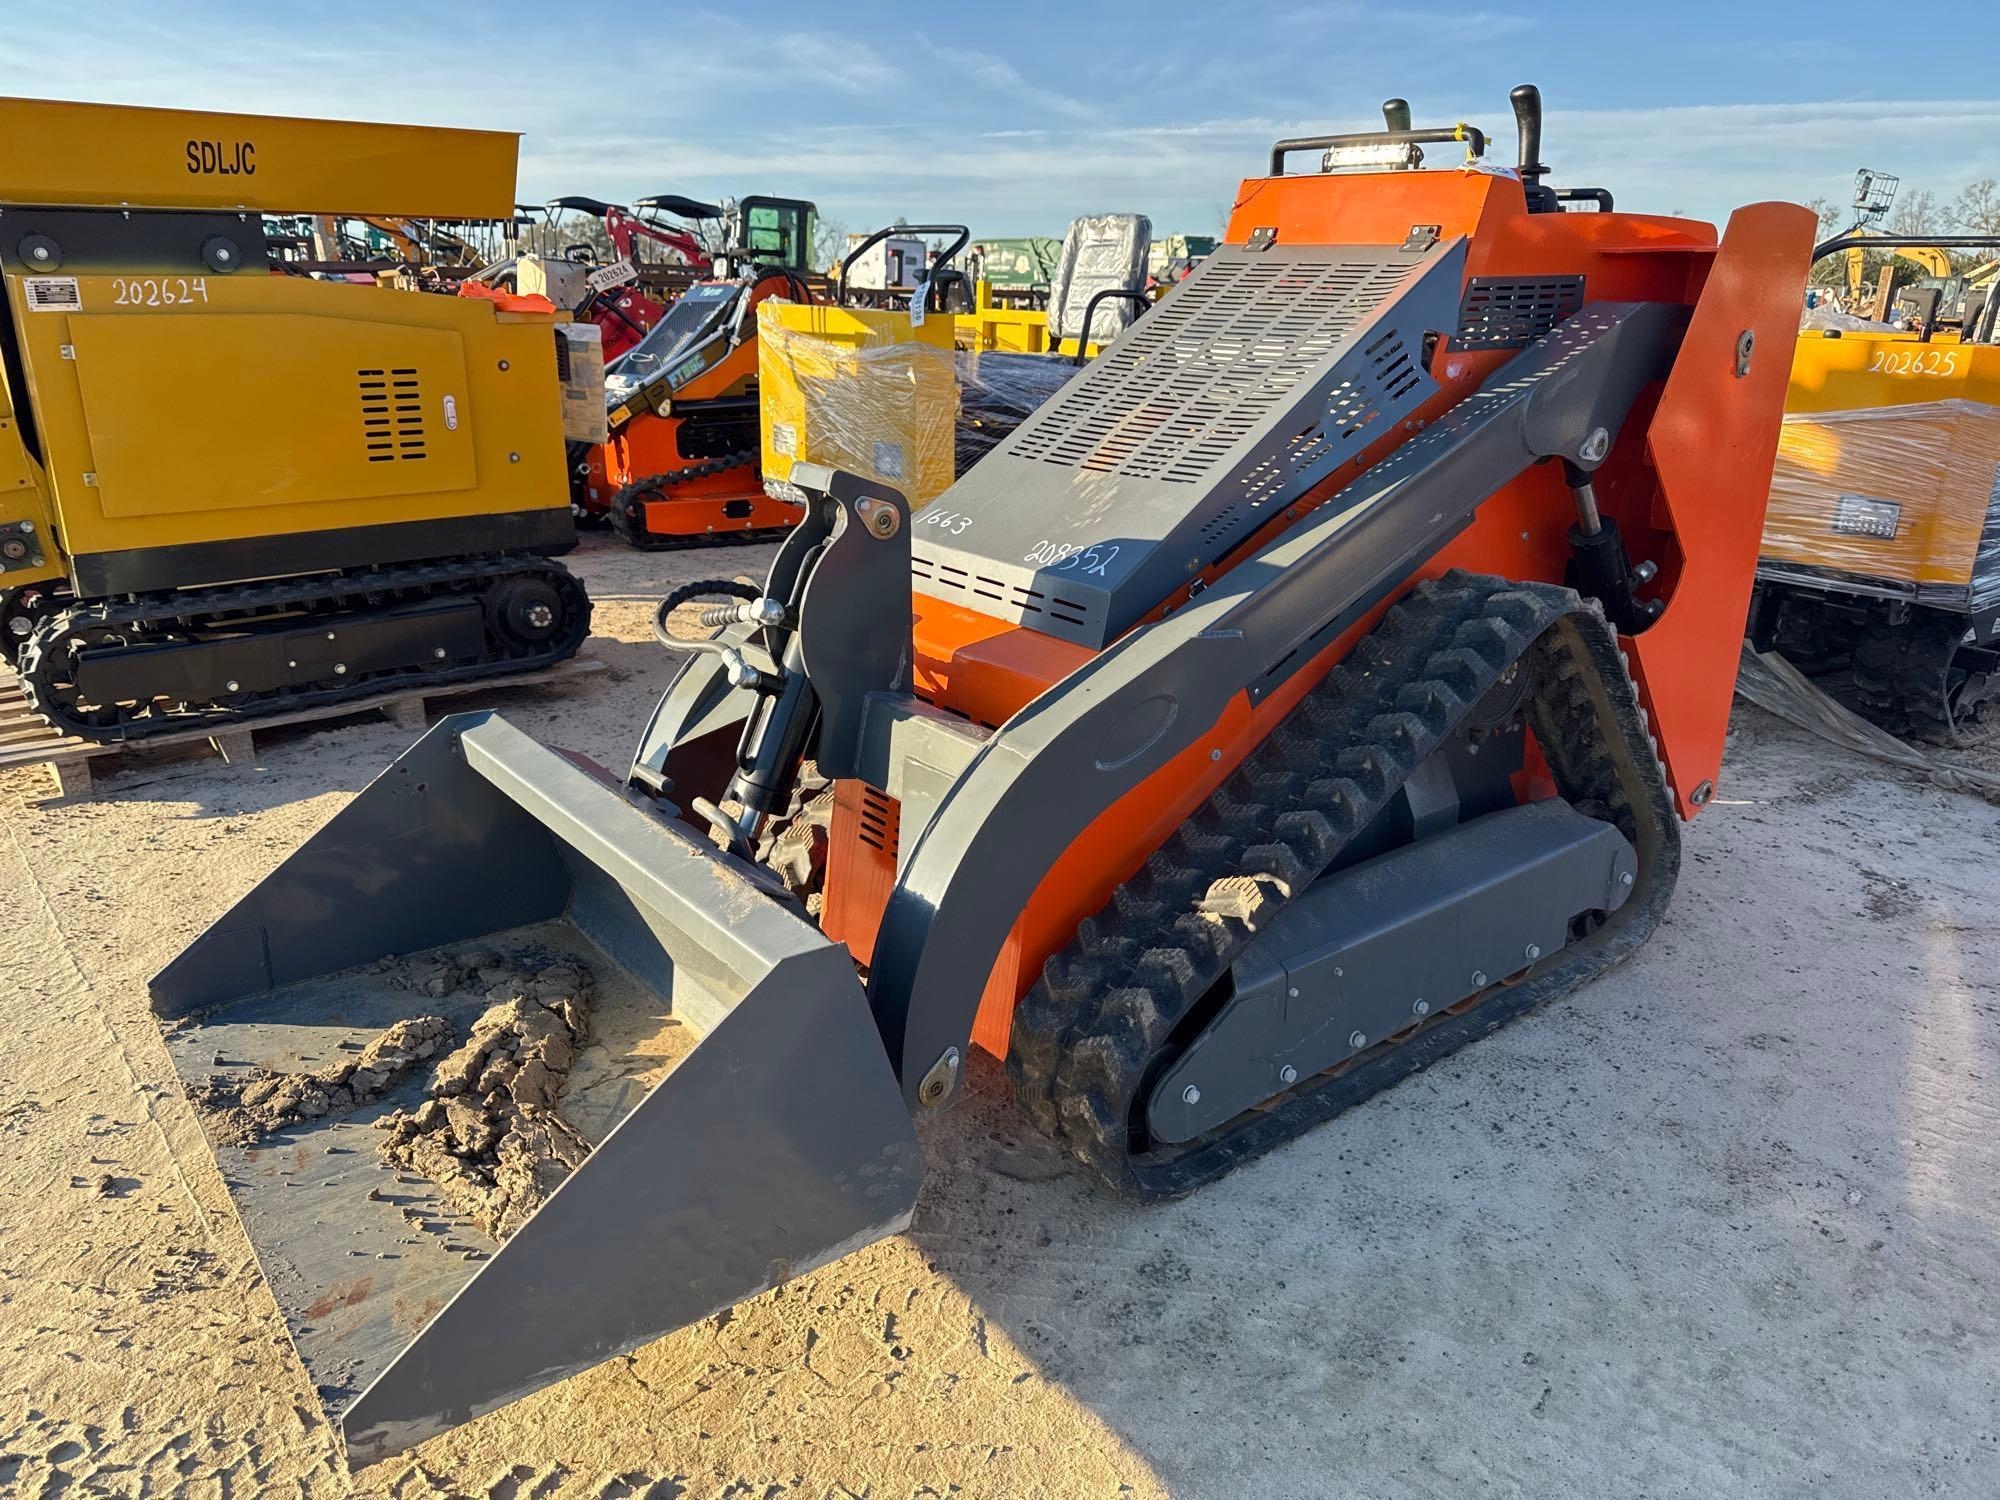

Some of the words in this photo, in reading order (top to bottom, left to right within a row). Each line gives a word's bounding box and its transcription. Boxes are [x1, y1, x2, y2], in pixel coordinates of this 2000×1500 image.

[186, 139, 256, 176] SDLJC
[598, 265, 629, 283] 202624
[112, 277, 209, 307] 202624
[1867, 350, 1959, 378] 202625
[916, 508, 974, 535] 1663
[1024, 540, 1120, 576] 208352
